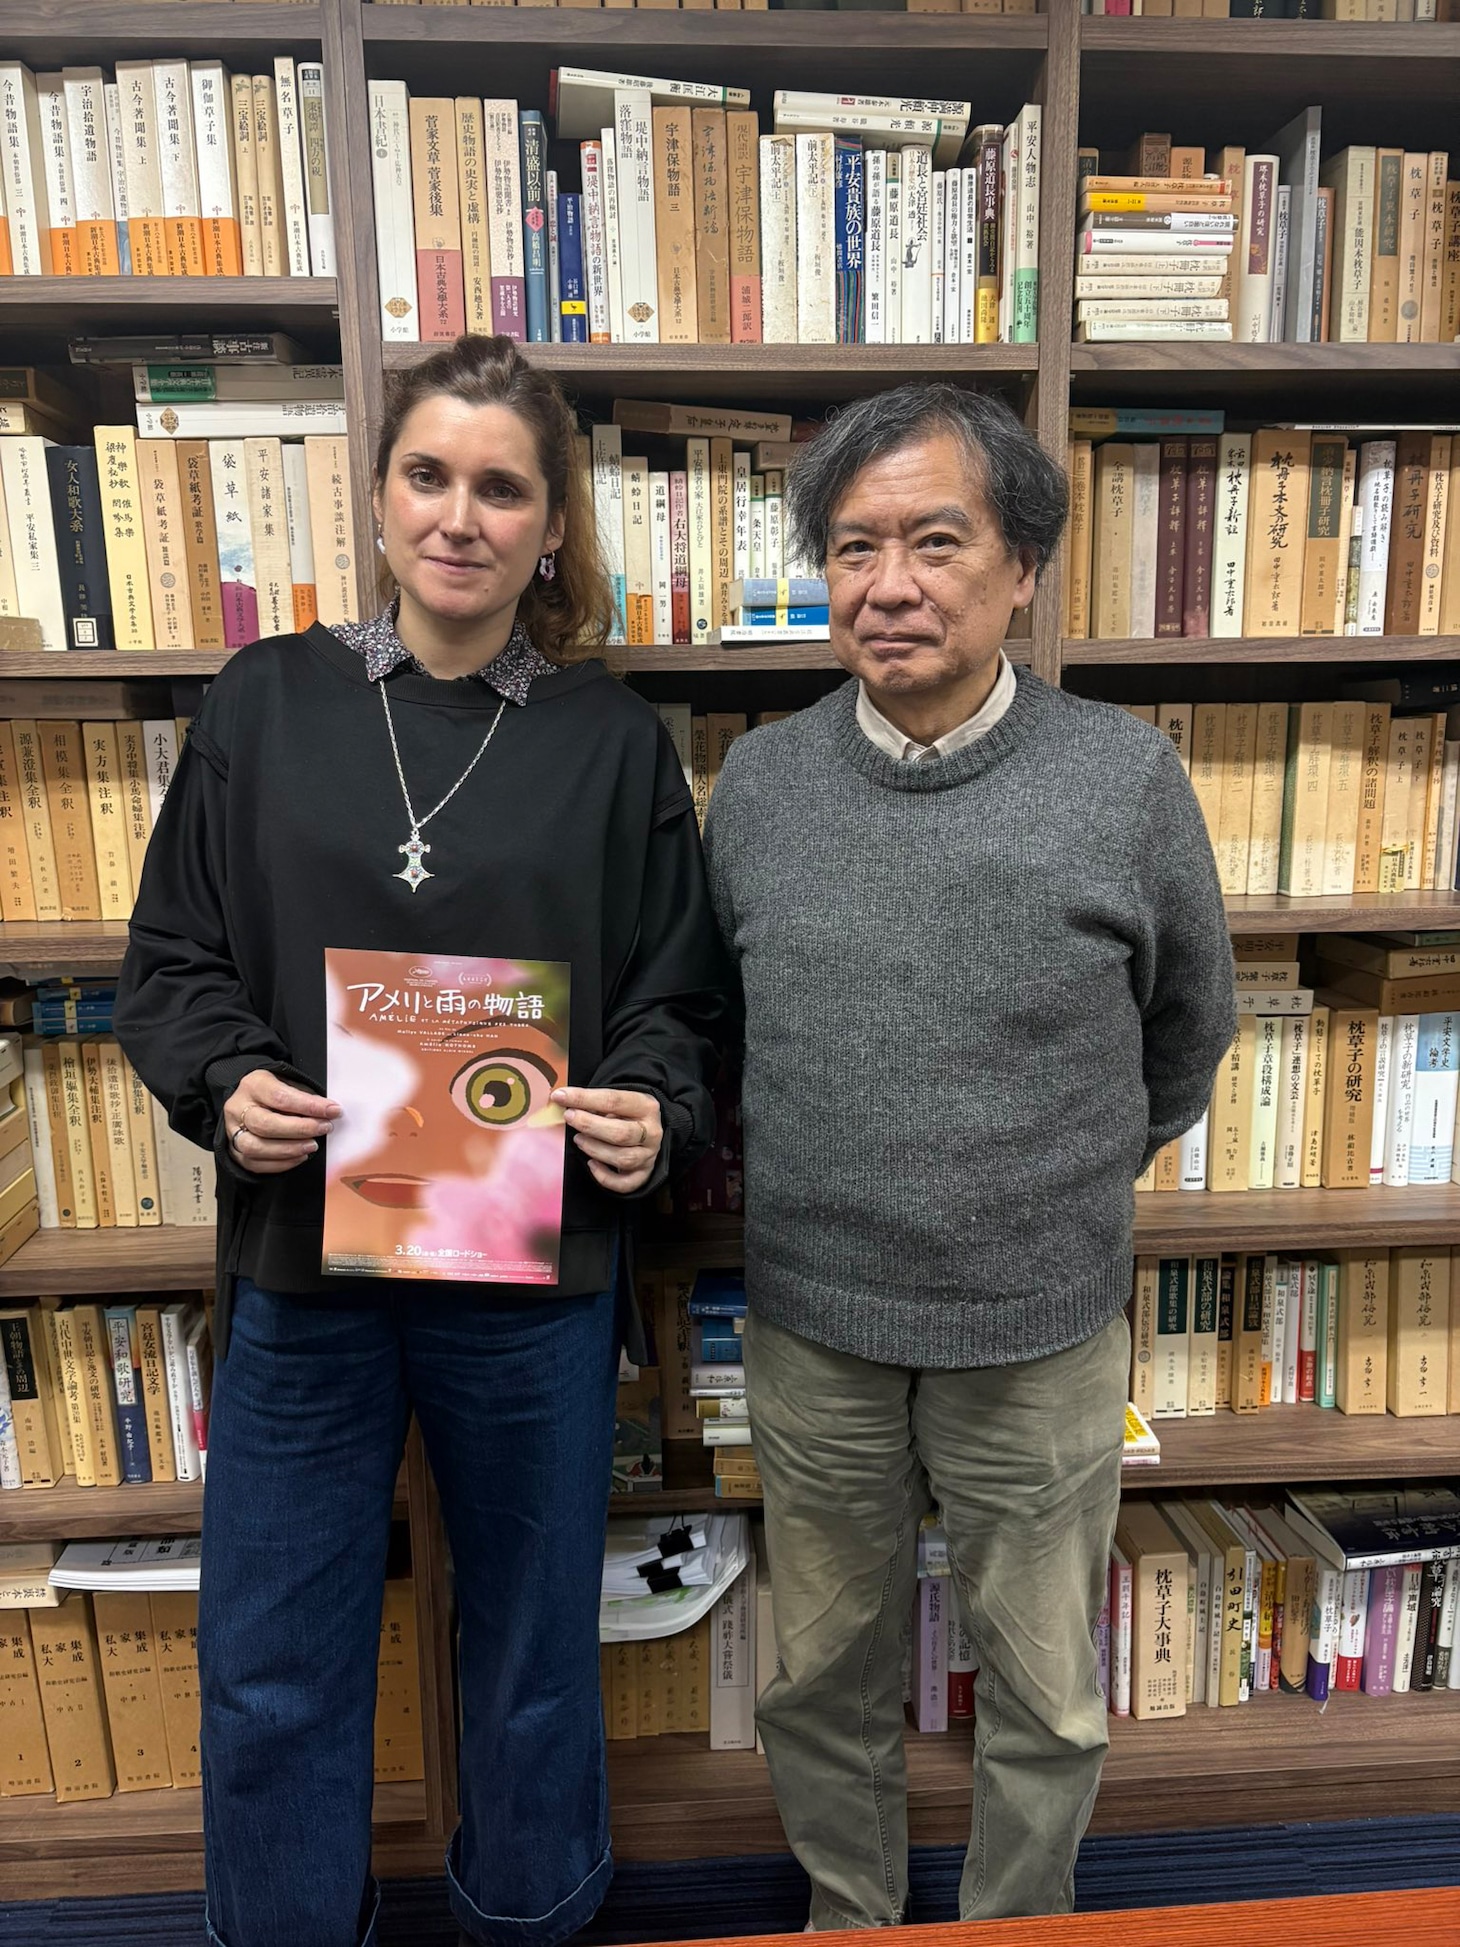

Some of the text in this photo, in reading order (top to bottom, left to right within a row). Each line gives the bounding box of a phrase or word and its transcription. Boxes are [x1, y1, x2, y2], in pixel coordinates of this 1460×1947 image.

[2, 79, 20, 149] 今昔物語集
[81, 84, 98, 162] 宇治拾遺物語
[131, 80, 148, 165] 古今著聞集 上
[164, 76, 181, 162] 古今著聞集 下
[202, 78, 218, 146] 御伽草子集
[237, 99, 250, 142] 三宝絵詞
[255, 99, 268, 142] 三宝絵詞
[280, 75, 295, 135] 無名草子
[374, 94, 388, 148] 日本書紀
[619, 104, 633, 159] 落窪物語
[48, 91, 66, 158] 今昔物語集
[59, 197, 68, 206] 四
[424, 114, 444, 217] 菅家文草 菅家後集
[460, 111, 480, 225] 歴史物語の史実と虚構
[525, 139, 542, 202] 清盛以前
[634, 121, 651, 203] 堤中納言物語
[665, 122, 681, 198] 宇津保物語
[1025, 120, 1038, 188] 平安人物志
[669, 202, 681, 213] 三
[734, 164, 754, 264] 宇津保物語
[845, 153, 863, 270] 平安貴族の世界
[870, 155, 882, 253] 孫の孫が語る藤原道長
[889, 187, 900, 240] 藤原道長
[916, 150, 929, 242] 道長と宮廷社会
[983, 147, 997, 221] 藤原道長事典
[1409, 166, 1423, 221] 枕草子
[586, 174, 604, 297] 堤中納言物語の新世界
[1430, 201, 1444, 250] 枕草子
[64, 458, 84, 533] 女人和歌大系
[153, 478, 169, 544] 袋草紙考証
[187, 454, 204, 518] 袋草紙考証
[221, 452, 243, 524] 袋草紙
[256, 448, 276, 537] 平安諸家集
[331, 474, 346, 548] 続古事談注解
[630, 471, 643, 525] 蜻蛉日記
[655, 484, 666, 522] 道綱母
[717, 453, 730, 579] 上東門院の系譜とその周辺
[736, 465, 748, 552] 皇居行幸年表
[1110, 460, 1125, 518] 全講枕草子
[1429, 472, 1445, 558] 枕草子研究及び資料
[673, 518, 688, 589] 右大将道綱母
[752, 508, 763, 553] 一条天皇
[769, 501, 780, 549] 藤原彰子
[19, 732, 42, 809] 源兼澄集全釈
[53, 733, 75, 810] 相模集全釈
[92, 738, 114, 815] 実方集注釈
[1363, 712, 1384, 810] 枕草子解釈の諸問題
[1396, 731, 1408, 771] 枕草子
[1414, 730, 1426, 770] 枕草子
[1307, 780, 1318, 793] 四
[1336, 779, 1349, 792] 五
[346, 982, 546, 1020] アメリと雨の物語
[1243, 995, 1303, 1010] 枕草子
[62, 1056, 82, 1127] 檜垣嫗集全釈
[86, 1056, 103, 1124] 伊勢大輔集注釈
[1260, 1021, 1275, 1108] 枕草子章段構成論
[1345, 1020, 1367, 1103] 枕草子の研究
[395, 1244, 422, 1256] 3.20
[1275, 1289, 1285, 1325] 和泉式部
[112, 1321, 133, 1403] 平安和歌研究
[140, 1322, 161, 1396] 宮廷女流日記文学
[1154, 1568, 1173, 1665] 枕草子大事典
[1225, 1566, 1243, 1632] 引田町史
[40, 1639, 83, 1655] 私家集
[105, 1631, 148, 1646] 私家集
[74, 1758, 82, 1768] 2
[136, 1747, 144, 1757] 3
[189, 1744, 198, 1753] 4
